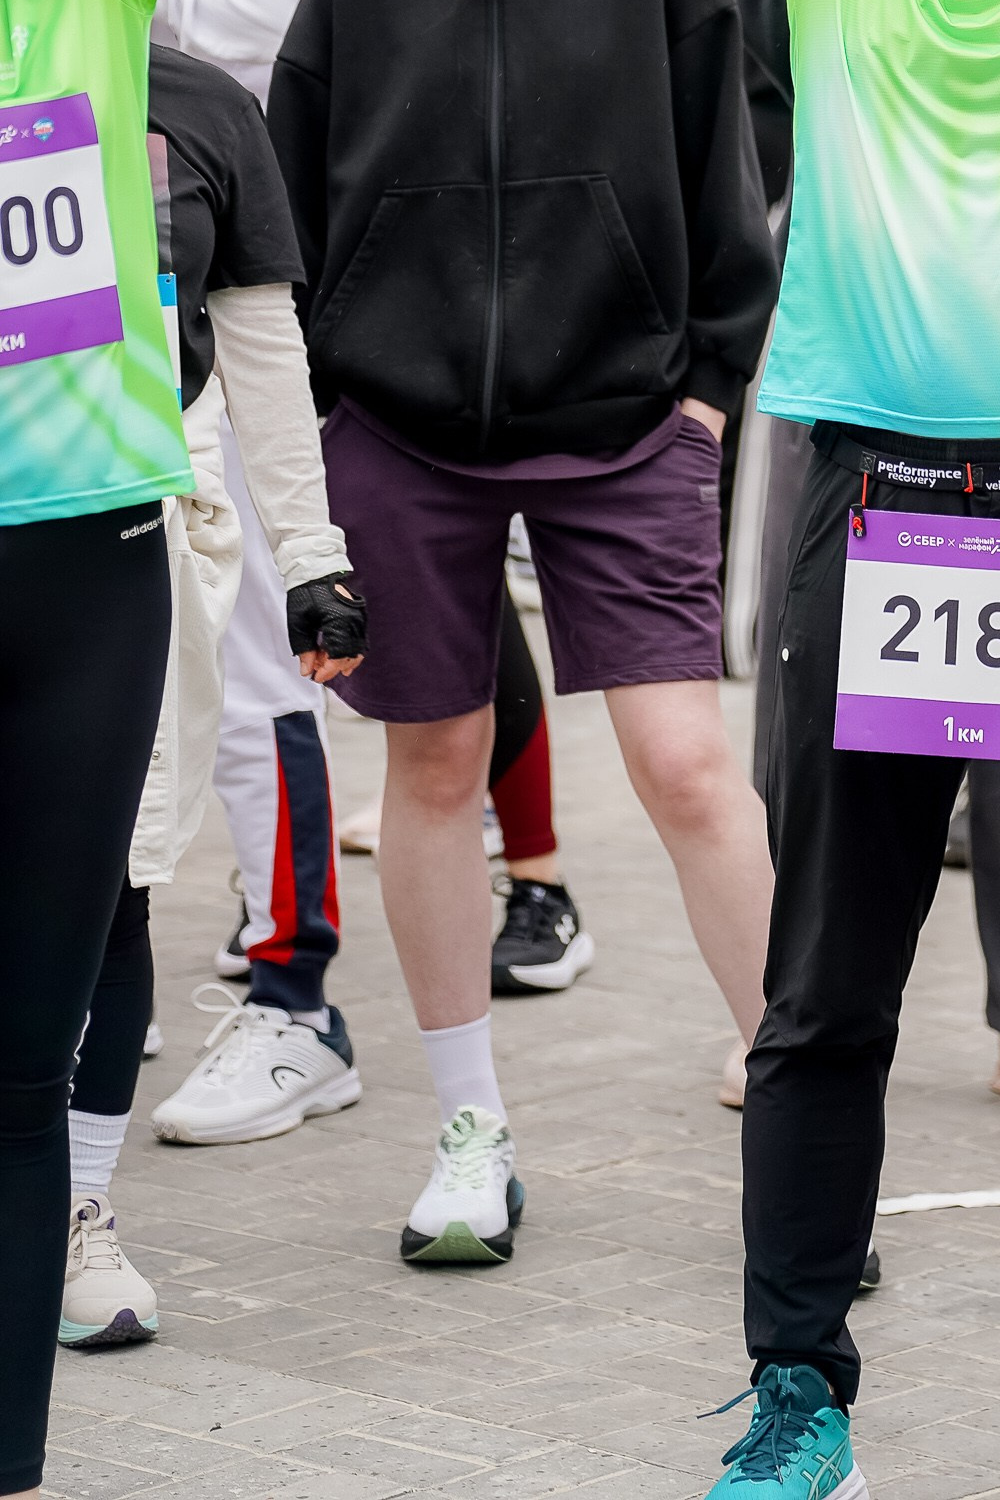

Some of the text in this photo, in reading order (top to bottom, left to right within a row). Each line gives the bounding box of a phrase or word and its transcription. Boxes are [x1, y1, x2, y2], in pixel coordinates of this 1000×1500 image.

[877, 460, 962, 479] performance
[887, 471, 937, 488] recovery
[120, 520, 158, 540] adidas
[913, 534, 945, 547] СБЕР
